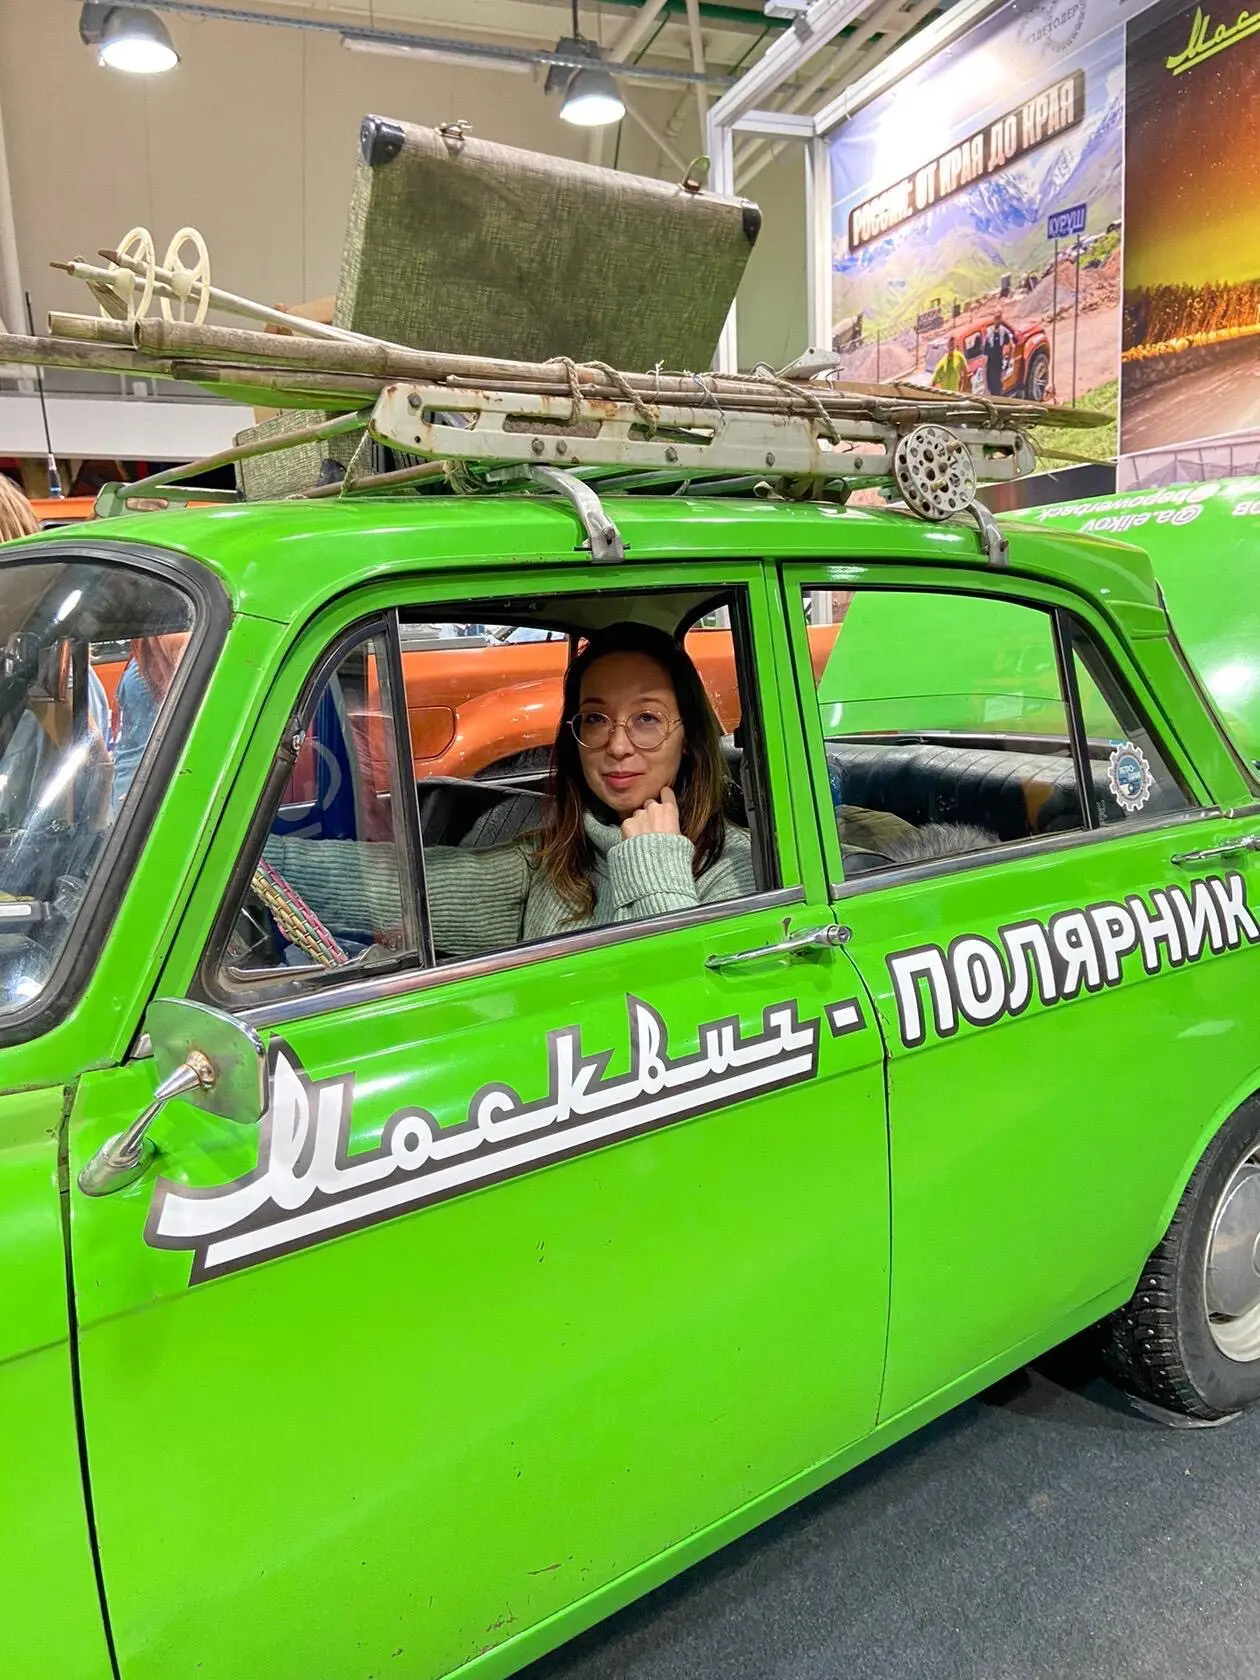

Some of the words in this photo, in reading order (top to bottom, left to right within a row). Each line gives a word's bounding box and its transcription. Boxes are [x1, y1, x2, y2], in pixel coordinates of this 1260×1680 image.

[915, 160, 938, 210] ОТ
[939, 133, 984, 197] КРАЯ
[987, 115, 1017, 172] ДО
[1022, 79, 1074, 149] КРАЯ
[1050, 208, 1084, 235] КУРУШ
[1078, 504, 1204, 533] @a.elikov
[888, 873, 1260, 1044] ПОЛЯРНИК
